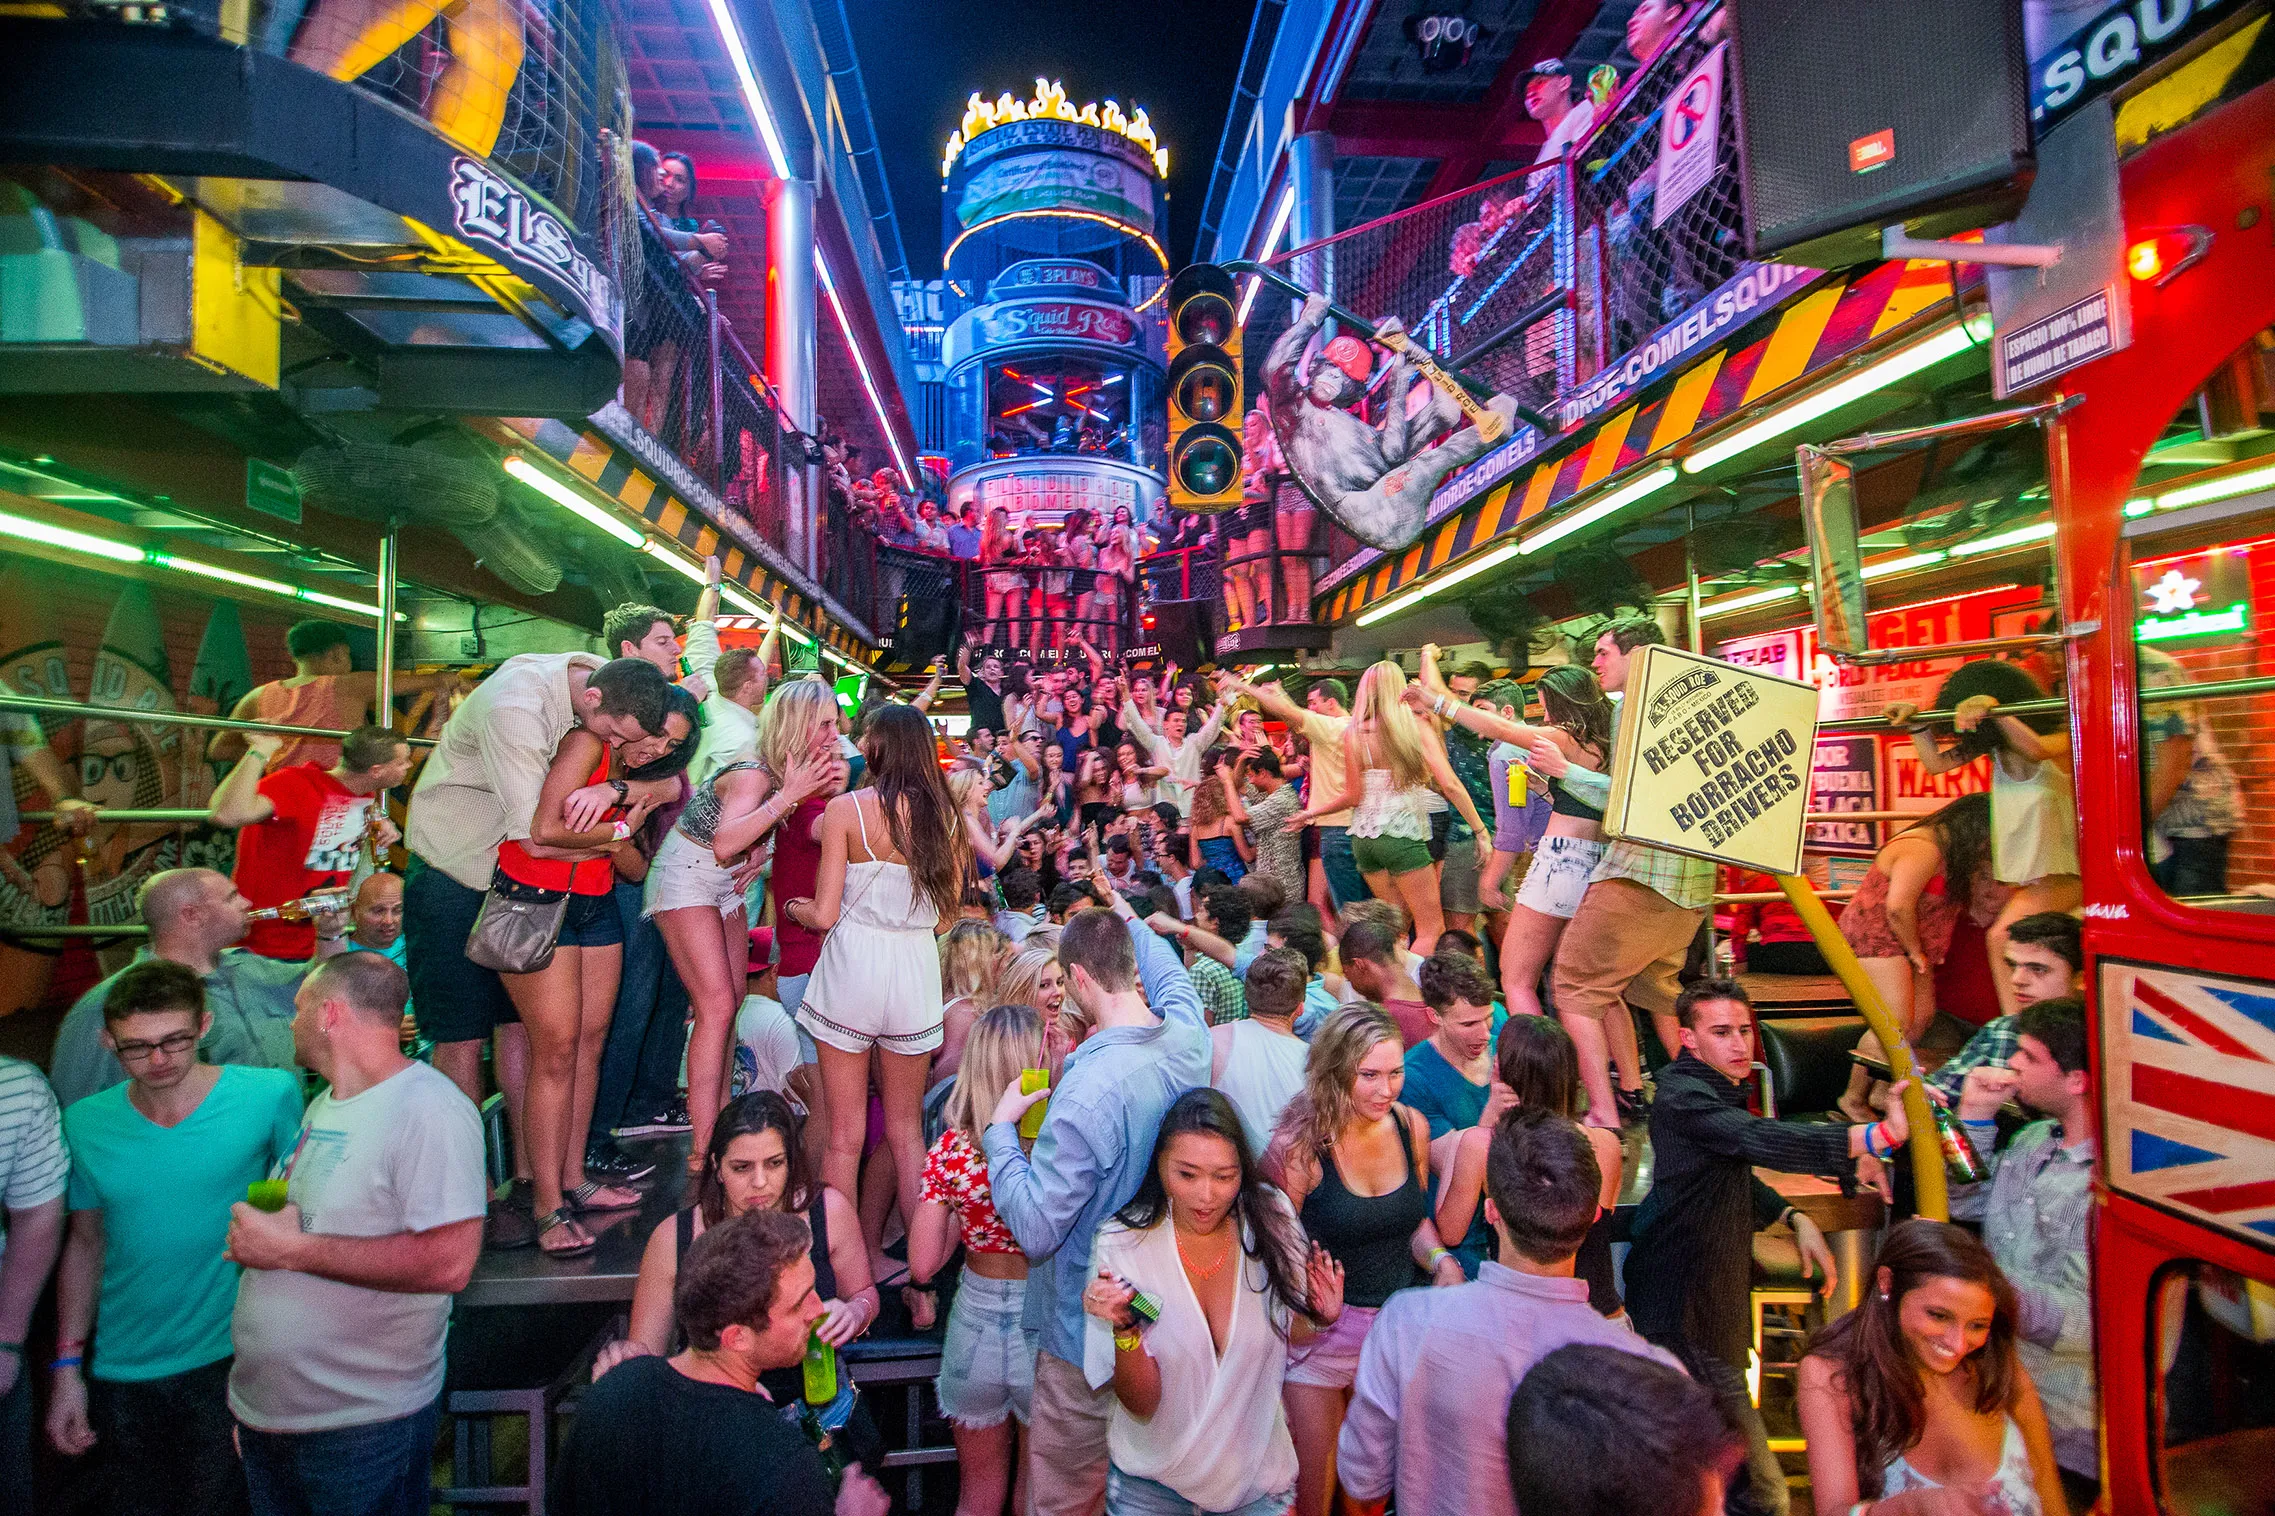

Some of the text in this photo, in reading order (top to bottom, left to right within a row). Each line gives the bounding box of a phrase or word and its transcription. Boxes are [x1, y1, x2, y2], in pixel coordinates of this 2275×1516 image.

[2008, 297, 2107, 359] ESPACIO 100% LIBRE
[2008, 325, 2109, 385] DE HUMO DE TABACO
[1654, 672, 1707, 716] EL SQUID ROE
[1667, 691, 1712, 725] CABO MEXICO
[1642, 680, 1760, 776] RESERVED
[1692, 729, 1746, 778] FOR
[1669, 728, 1798, 833] BORRACHO
[1699, 763, 1802, 850] DRIVERS
[1896, 754, 1993, 799] WARN
